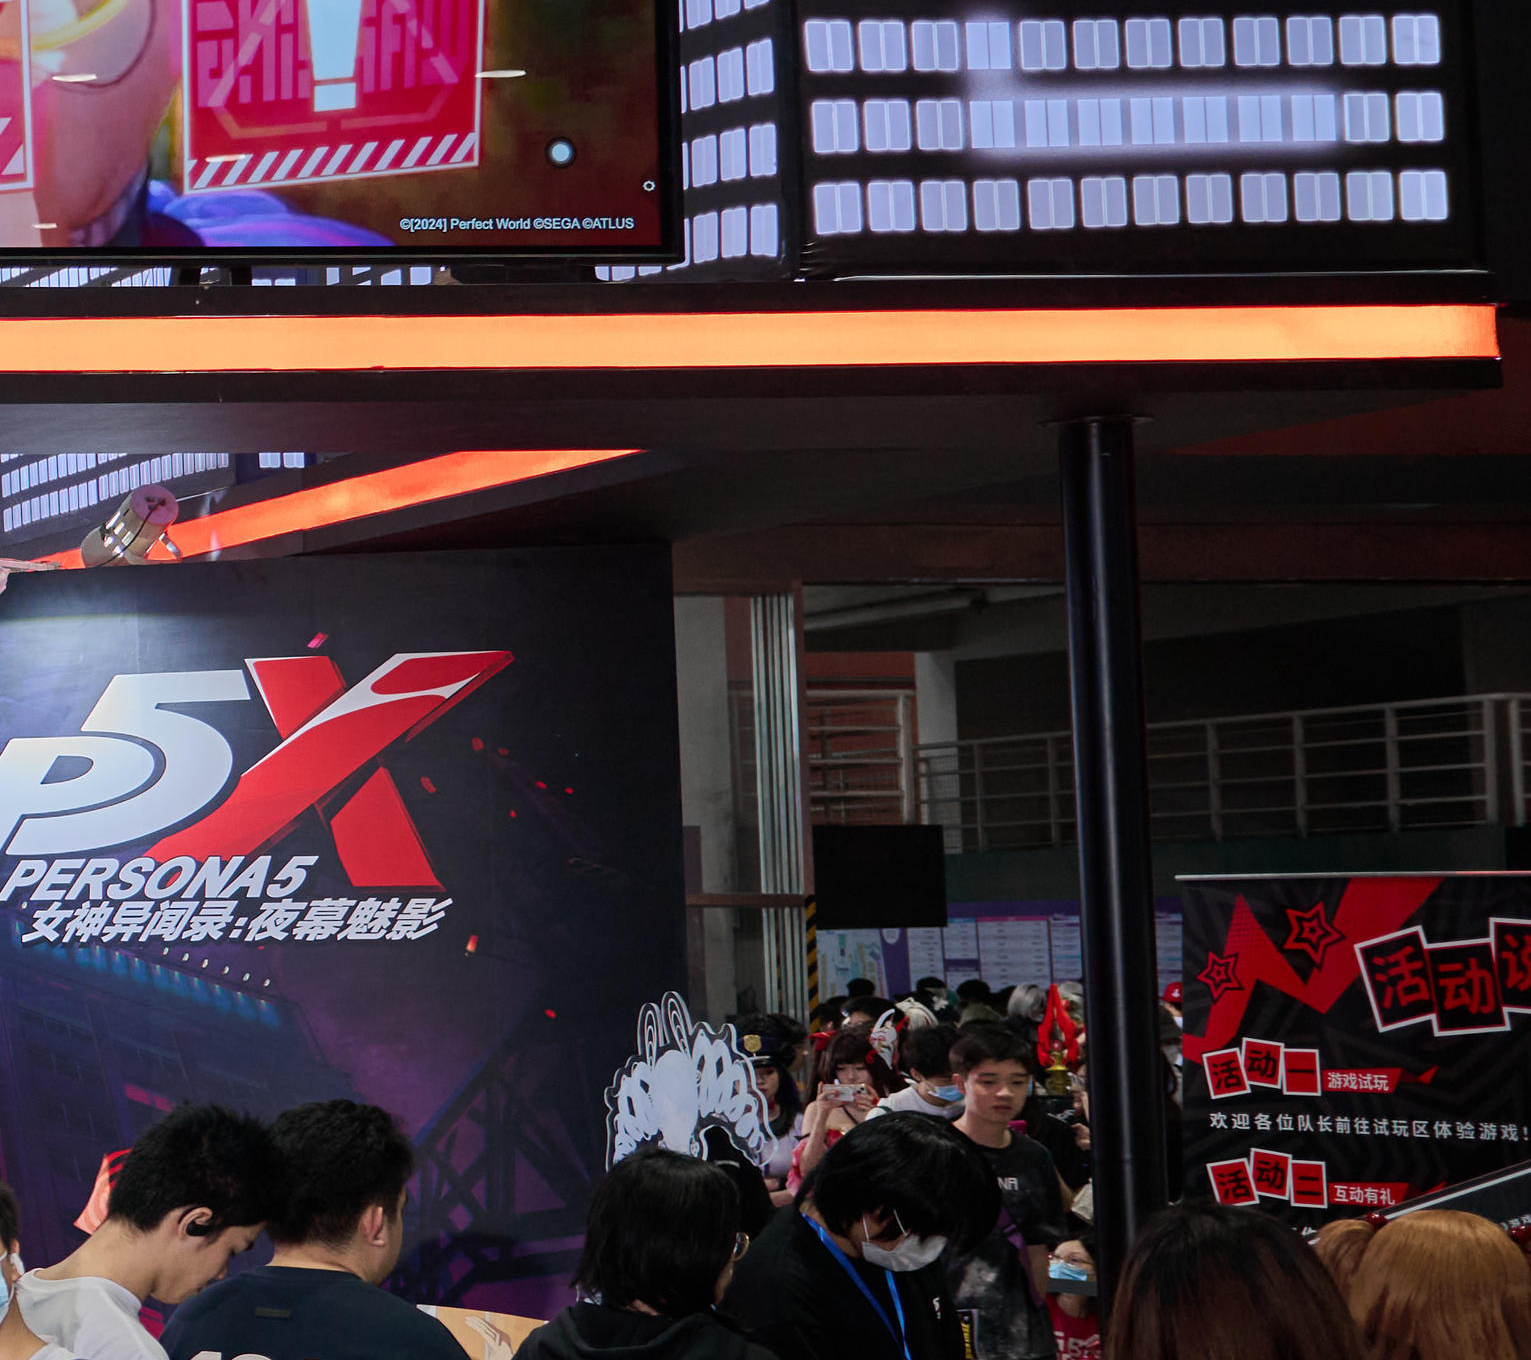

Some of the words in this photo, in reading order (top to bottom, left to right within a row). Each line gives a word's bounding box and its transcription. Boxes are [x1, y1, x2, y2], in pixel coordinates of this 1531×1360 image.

[450, 218, 494, 230] Perfect
[496, 218, 531, 230] World
[20, 897, 453, 943] 女神异闻录:夜幕魅影
[1327, 1071, 1390, 1093] 游戏试玩
[1333, 1183, 1396, 1207] 互动有礼
